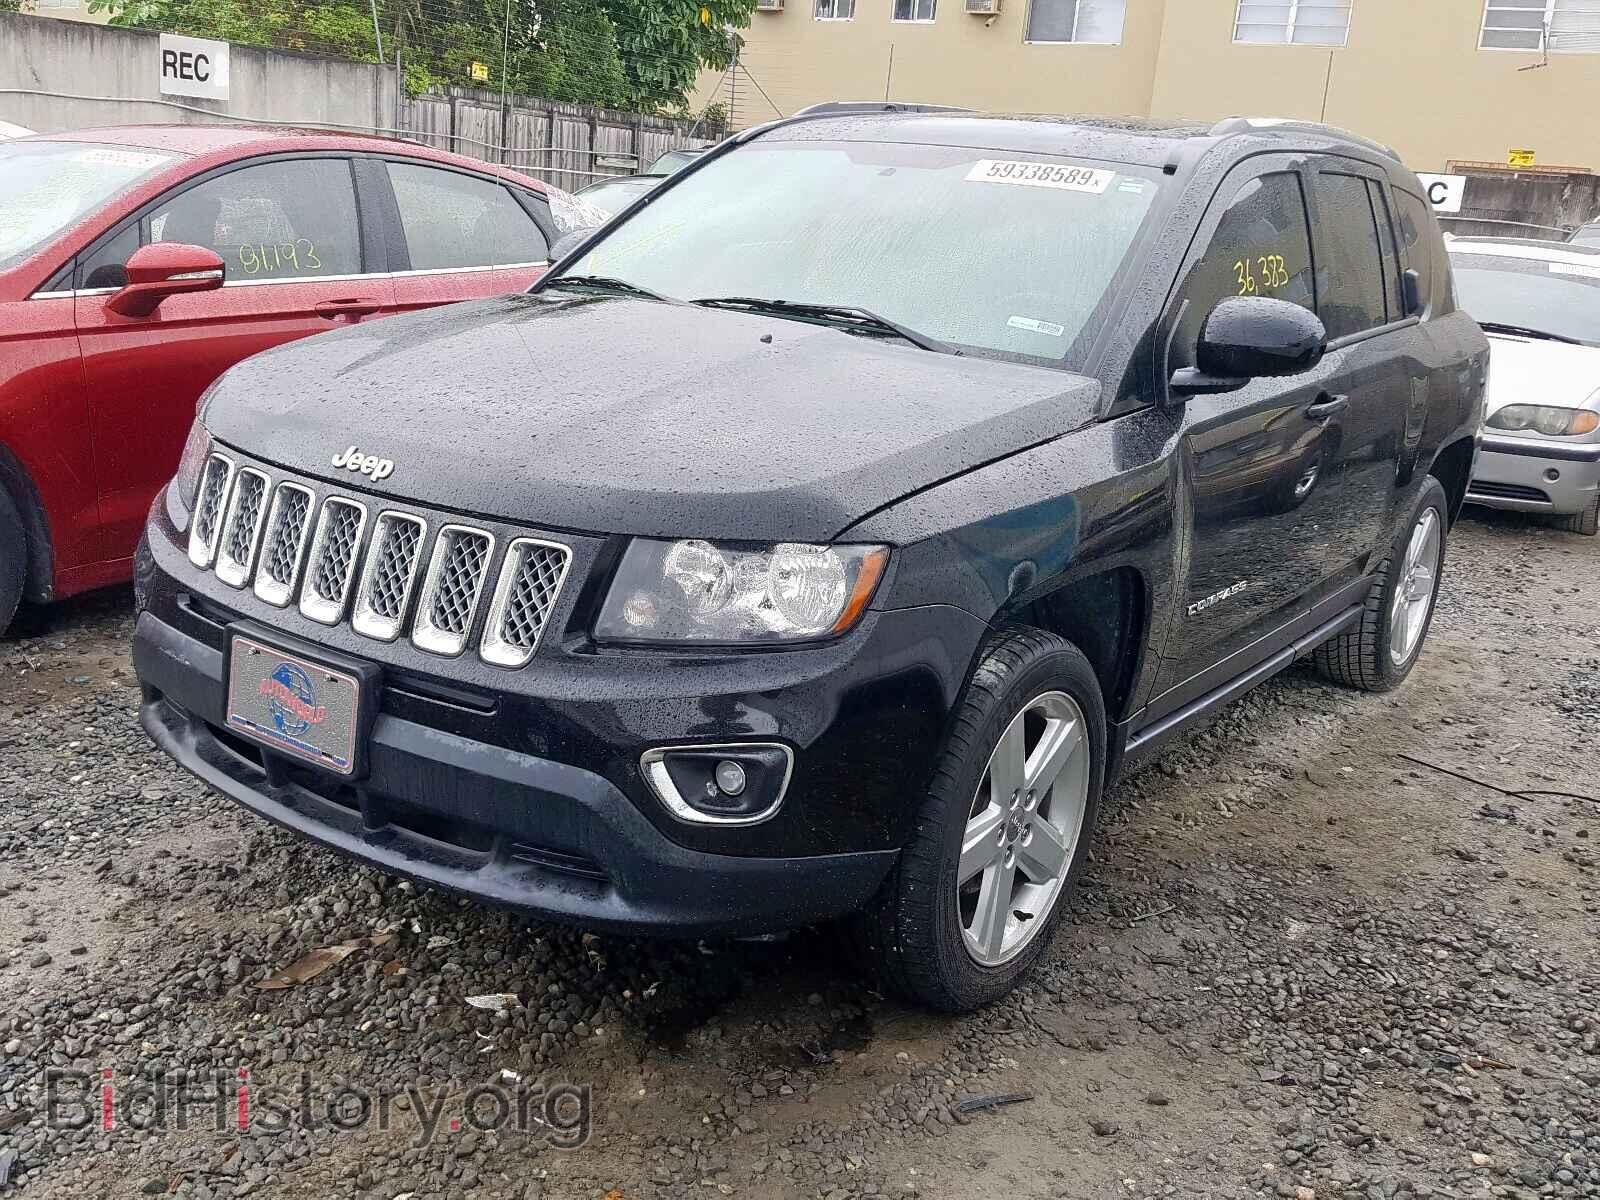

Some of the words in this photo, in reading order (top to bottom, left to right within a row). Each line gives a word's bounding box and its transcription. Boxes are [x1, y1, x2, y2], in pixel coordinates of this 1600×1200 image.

[163, 48, 210, 82] REC
[986, 162, 1094, 186] 59338589
[1233, 255, 1288, 295] 36,383
[331, 445, 395, 483] Jeep
